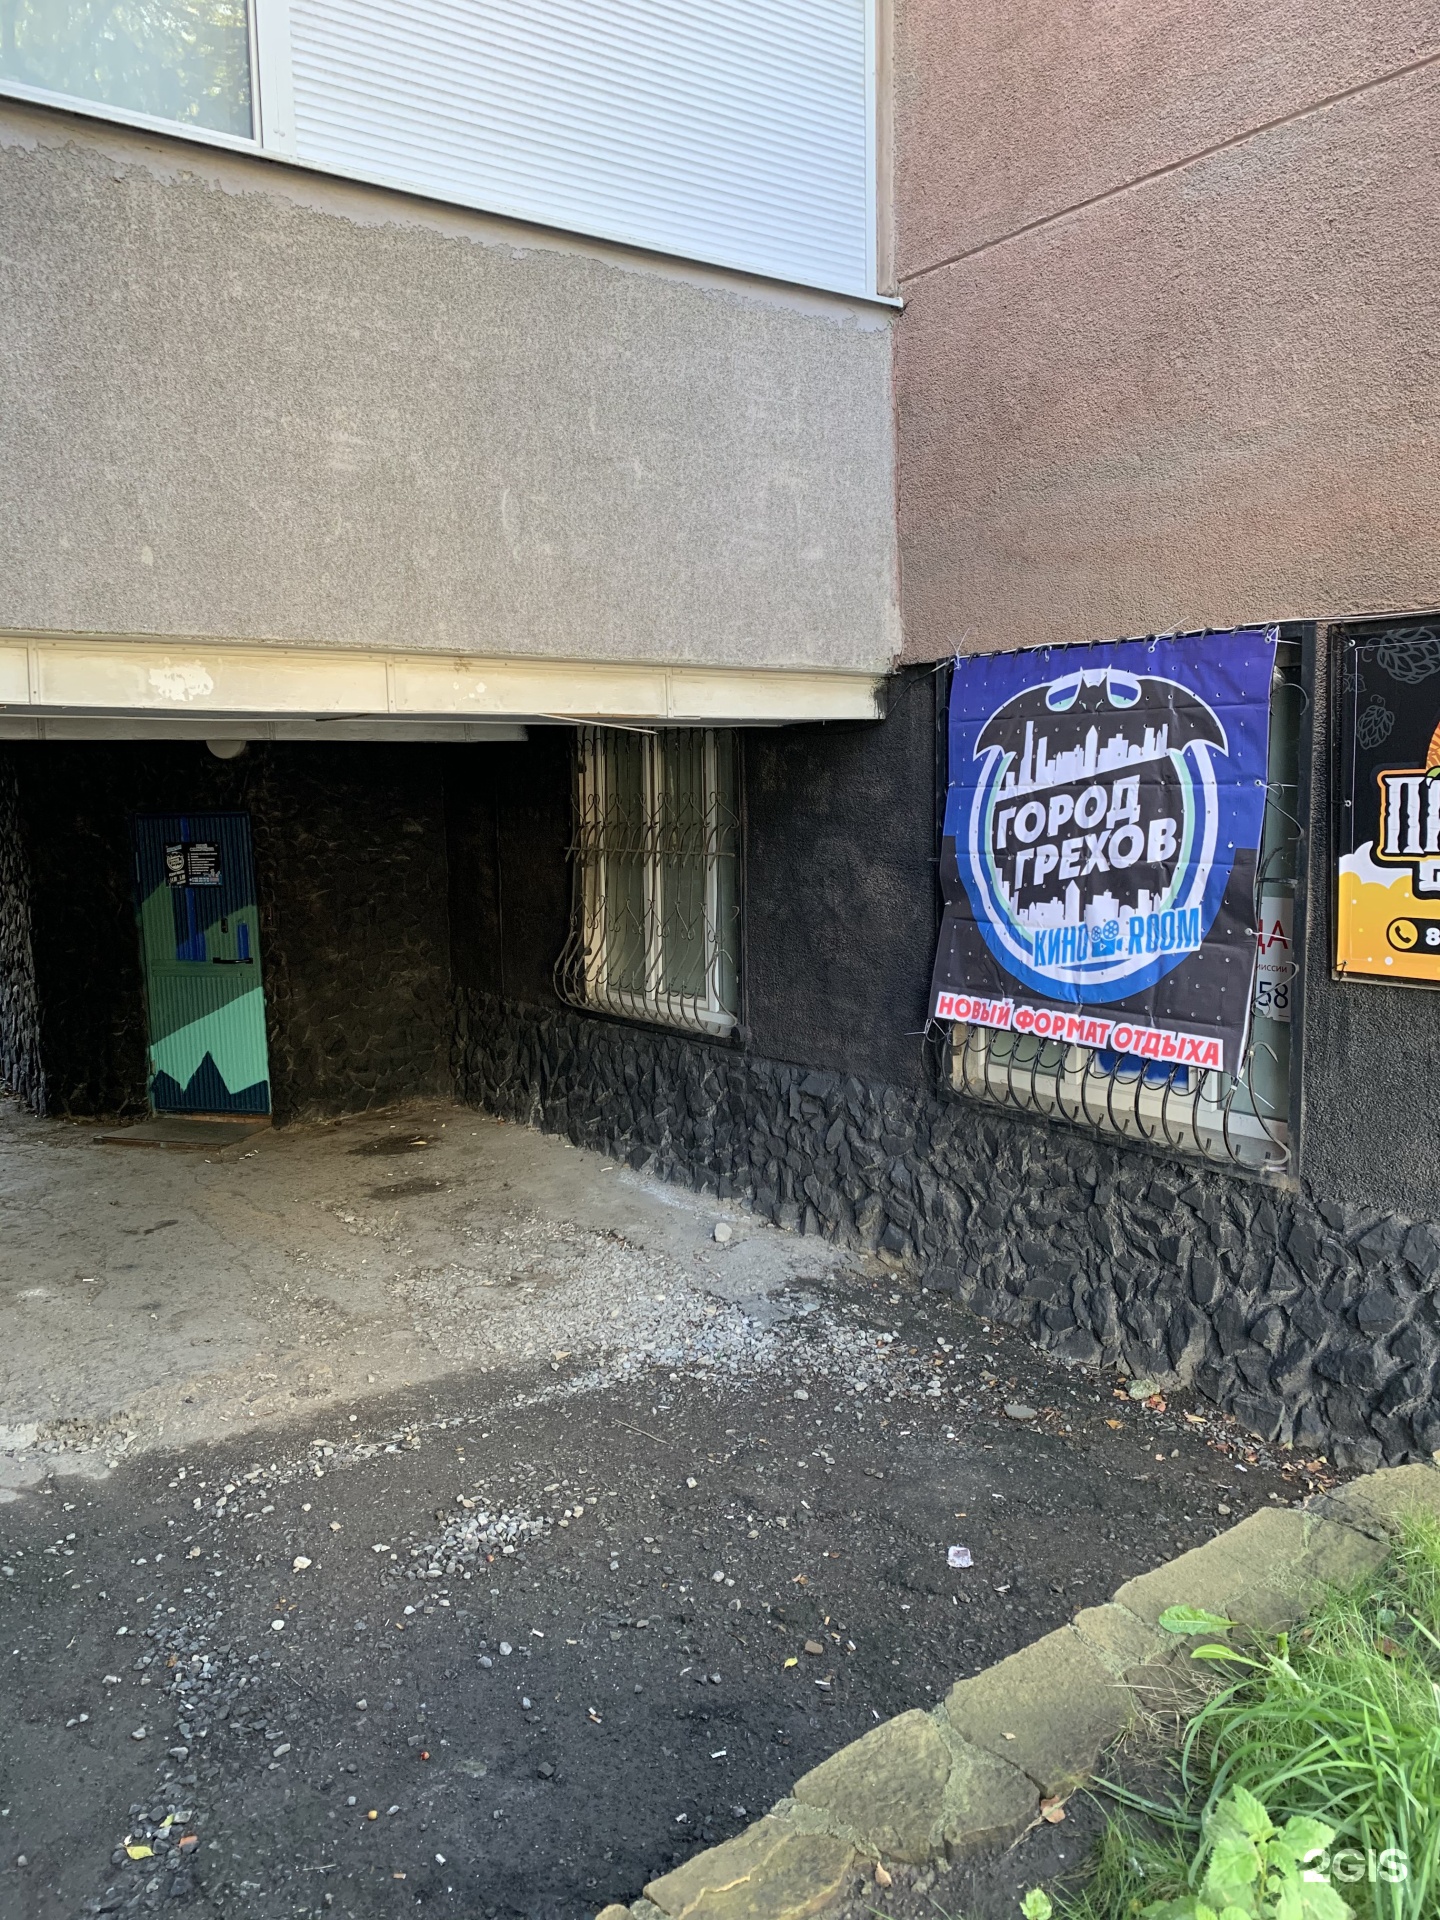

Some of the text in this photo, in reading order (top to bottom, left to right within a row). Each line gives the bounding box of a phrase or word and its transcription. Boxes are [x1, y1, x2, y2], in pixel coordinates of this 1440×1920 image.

[996, 774, 1141, 850] ГОРОД
[1014, 817, 1178, 890] ГРЕХОВ
[1033, 907, 1201, 967] КИНО ROOM
[938, 995, 1221, 1067] НОВЫЙ ФОРМАТ ОТДЫХА
